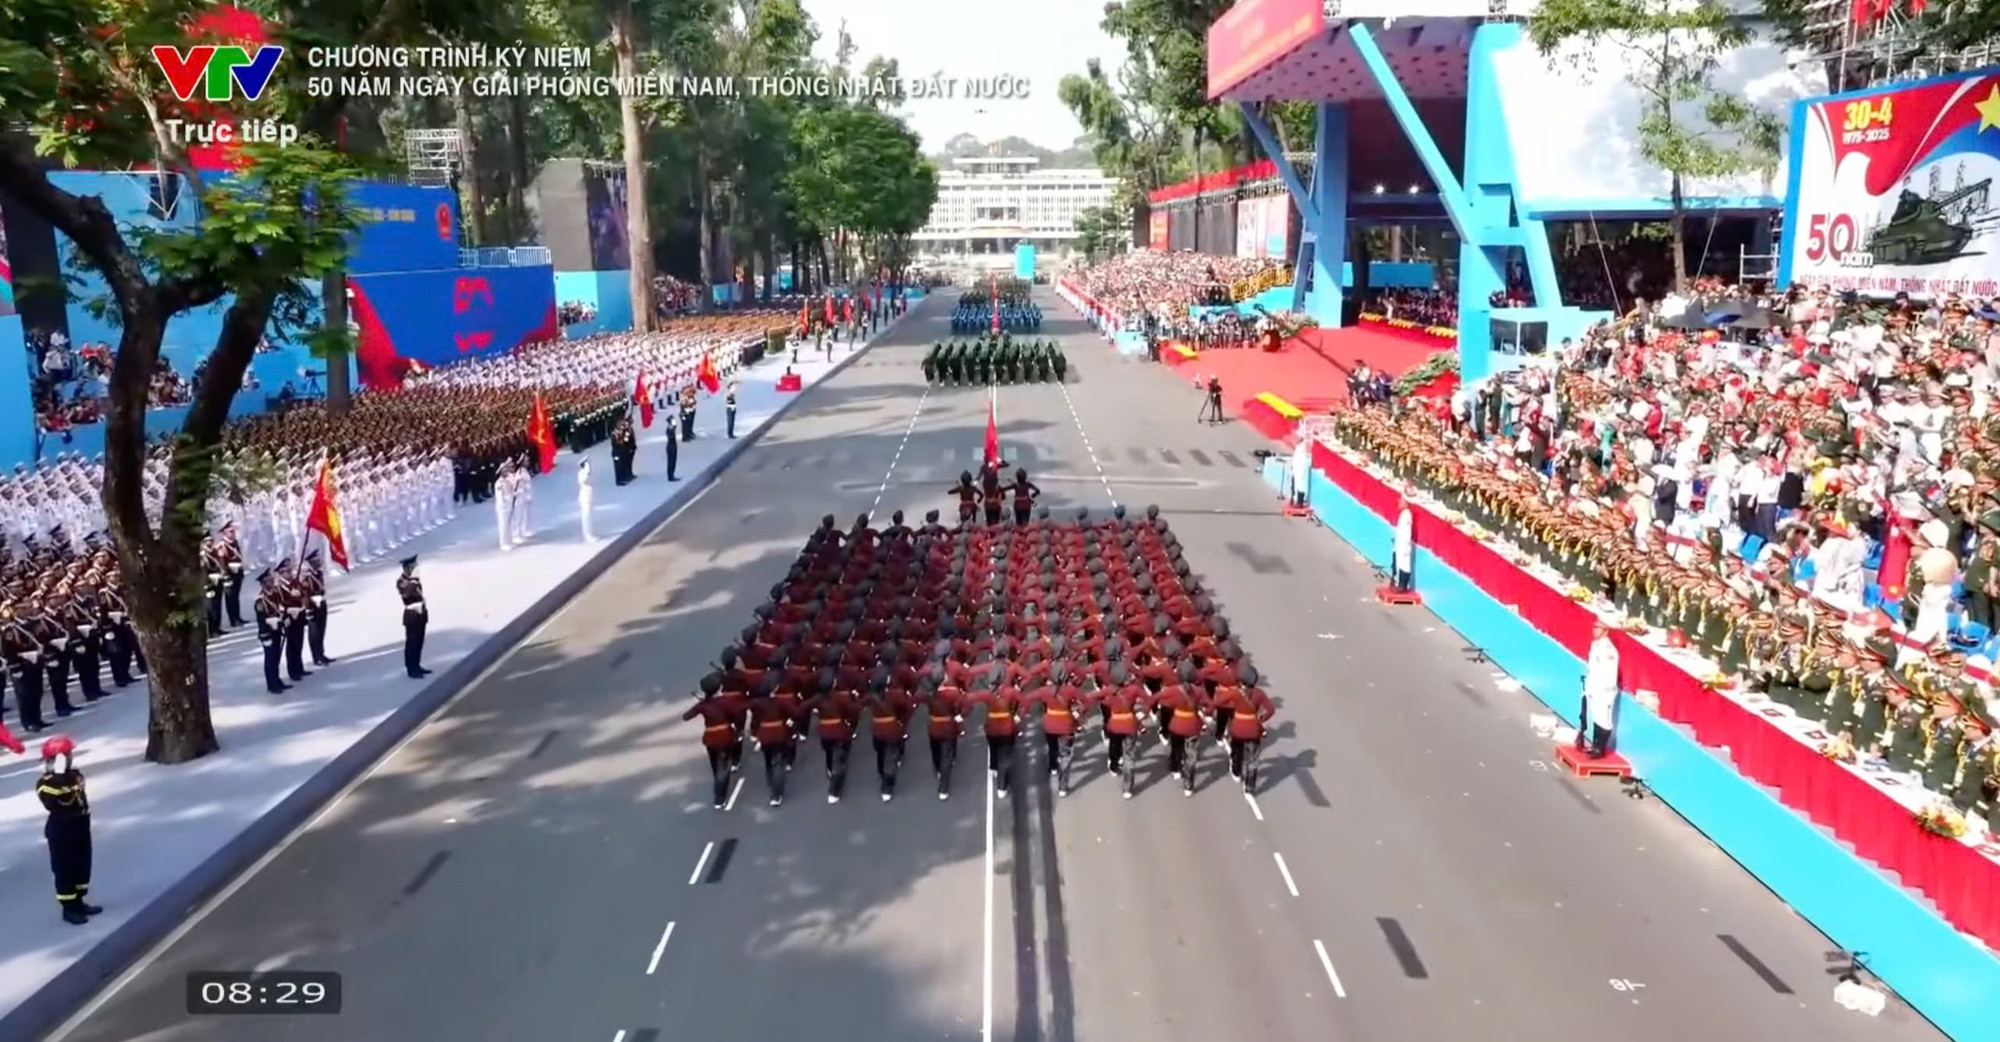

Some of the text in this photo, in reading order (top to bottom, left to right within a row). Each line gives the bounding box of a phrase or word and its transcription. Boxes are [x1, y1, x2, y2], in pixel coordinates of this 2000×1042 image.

[1844, 97, 1893, 130] 30-4
[1842, 127, 1890, 145] 1975-2025
[1806, 213, 1855, 262] 50
